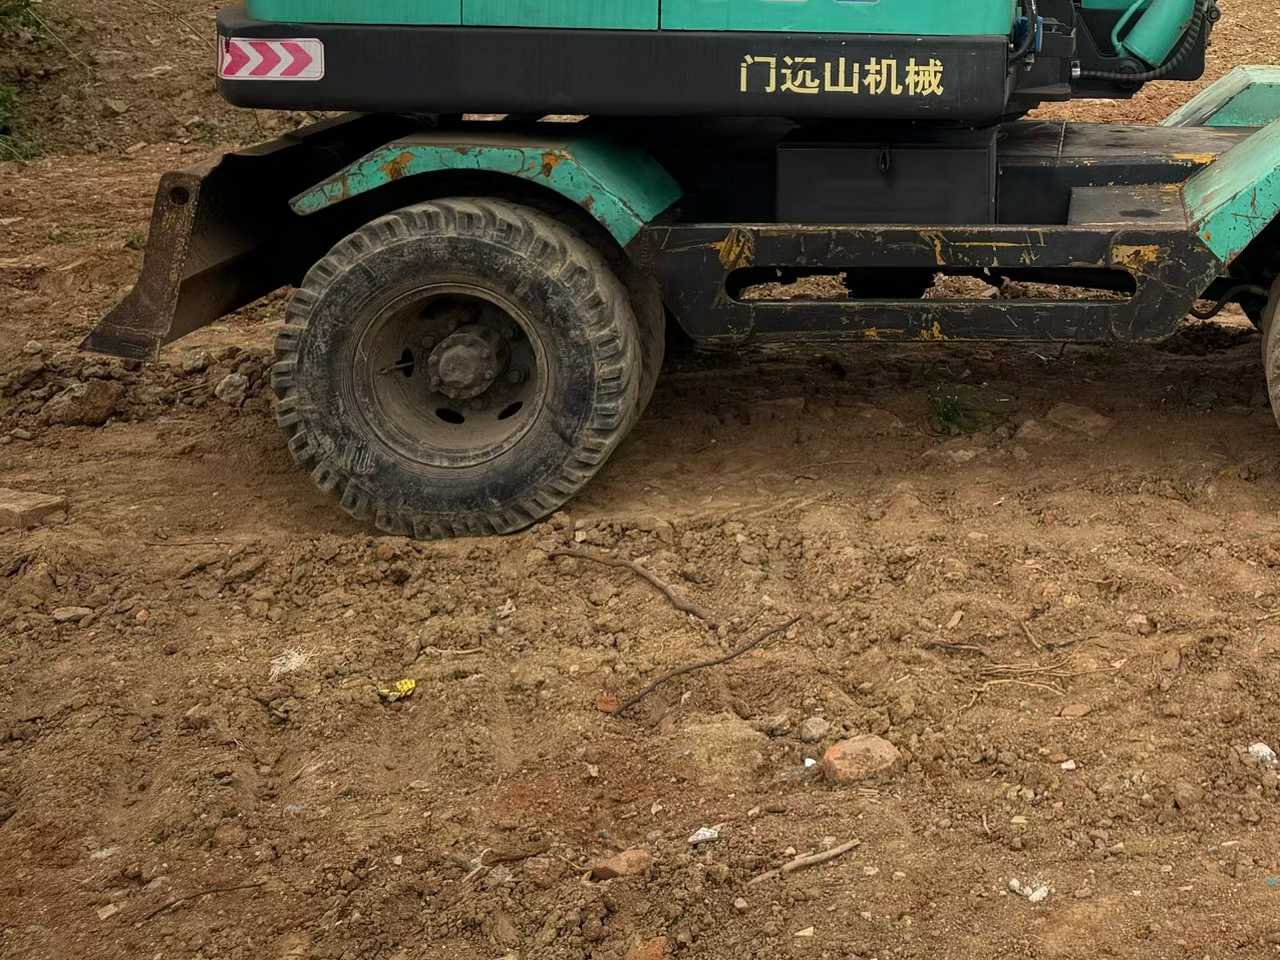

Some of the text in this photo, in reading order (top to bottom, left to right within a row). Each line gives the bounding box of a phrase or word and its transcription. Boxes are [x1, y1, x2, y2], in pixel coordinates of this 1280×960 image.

[740, 54, 944, 96] 门远山机械
